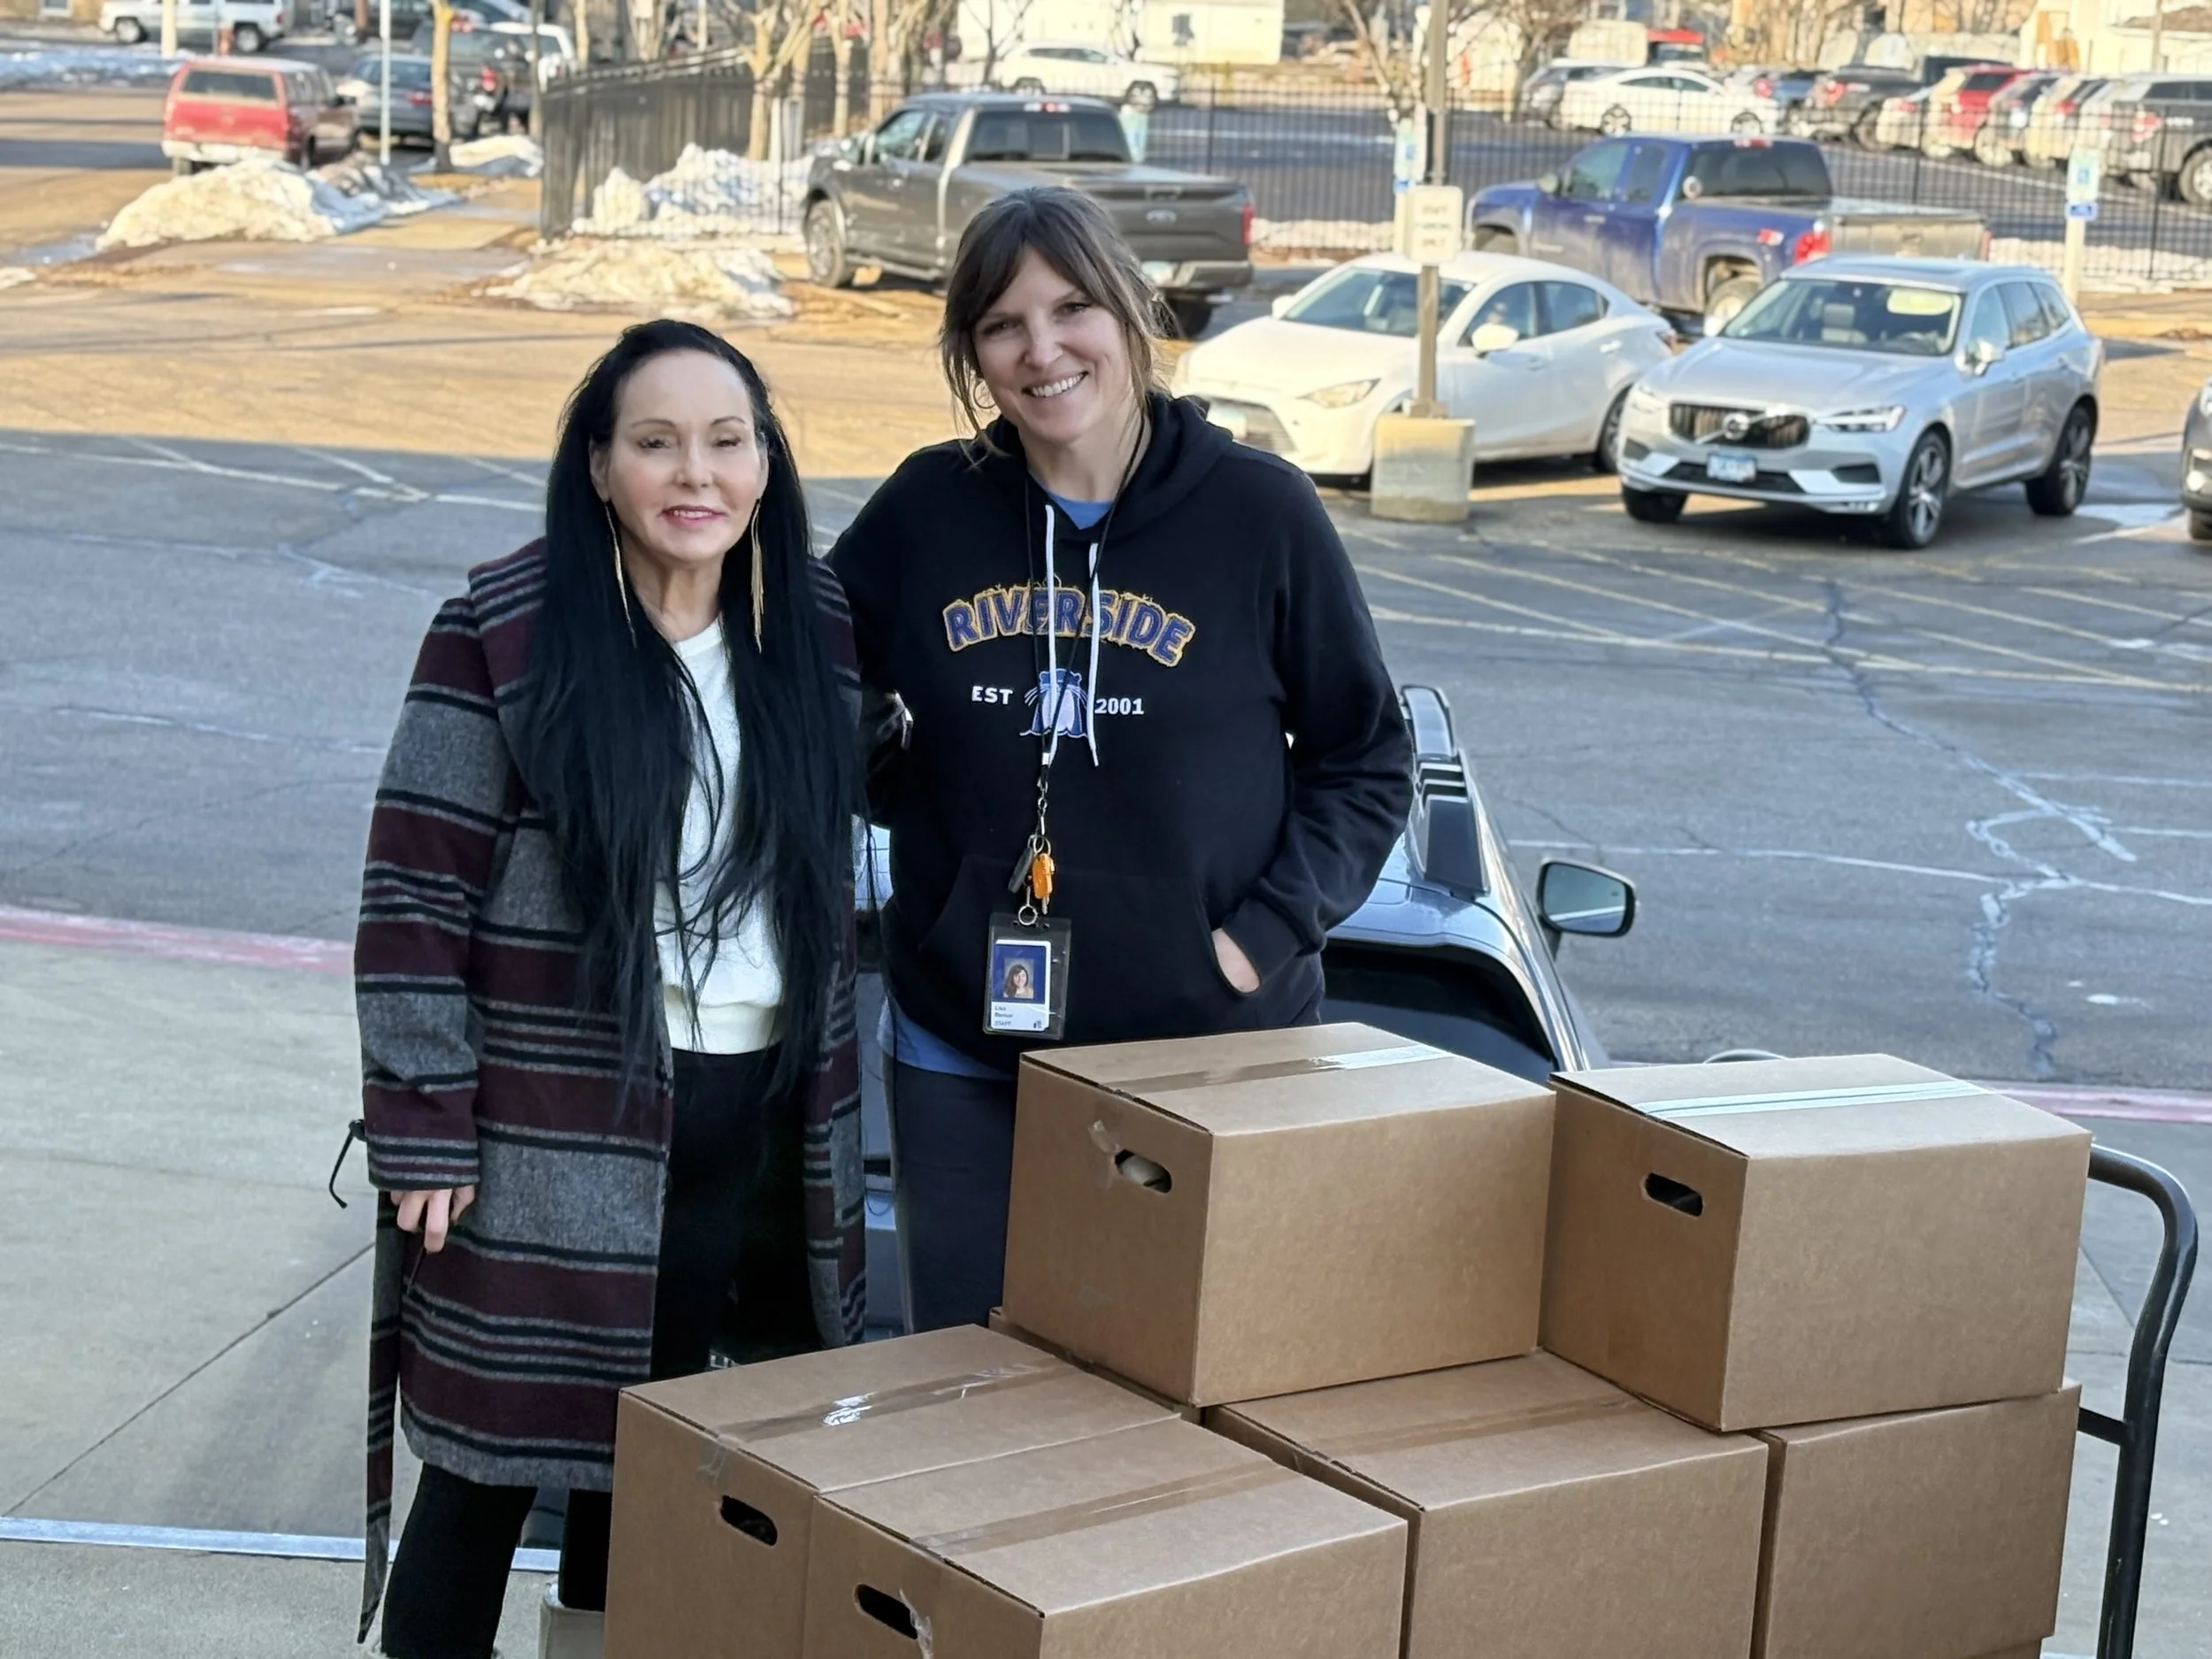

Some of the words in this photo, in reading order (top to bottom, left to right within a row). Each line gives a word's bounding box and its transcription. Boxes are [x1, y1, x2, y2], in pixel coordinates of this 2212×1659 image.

[941, 584, 1196, 668] RIVERSIDE
[972, 685, 1014, 706] EST
[1094, 696, 1145, 717] 2001
